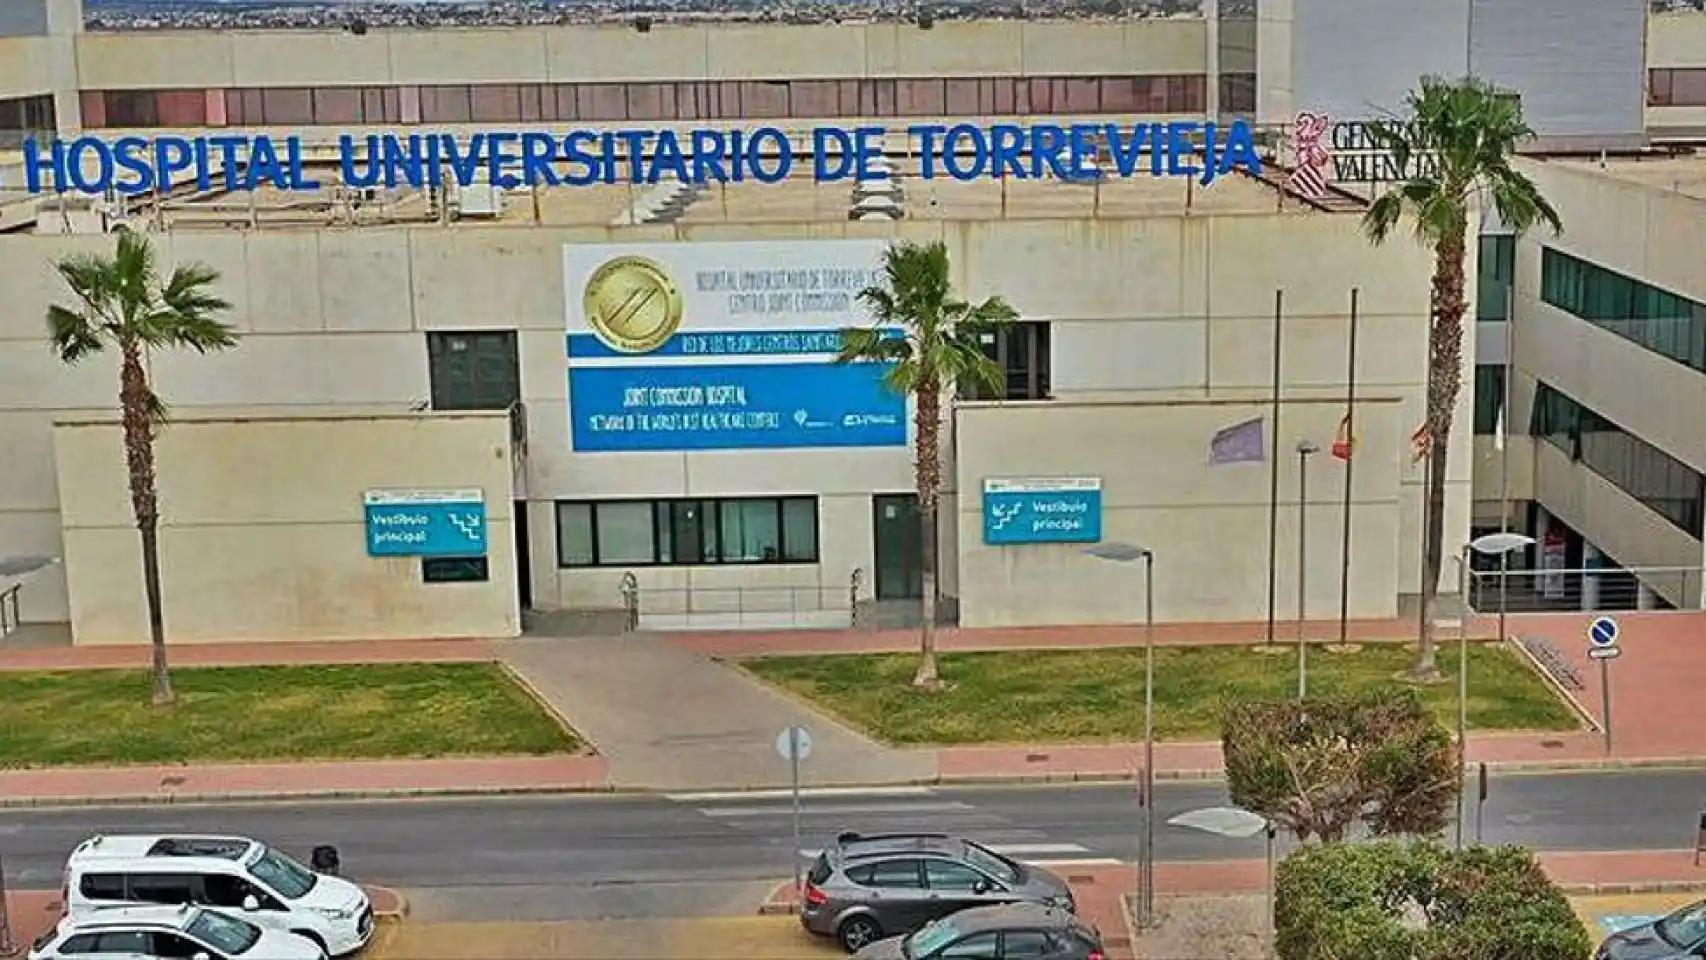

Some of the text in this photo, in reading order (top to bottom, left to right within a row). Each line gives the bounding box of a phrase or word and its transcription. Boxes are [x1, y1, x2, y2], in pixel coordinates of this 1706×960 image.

[24, 120, 1262, 194] HOSPITAL UNIVERSITARIO DE TORREVIEJA
[1333, 154, 1443, 181] VALENCIA
